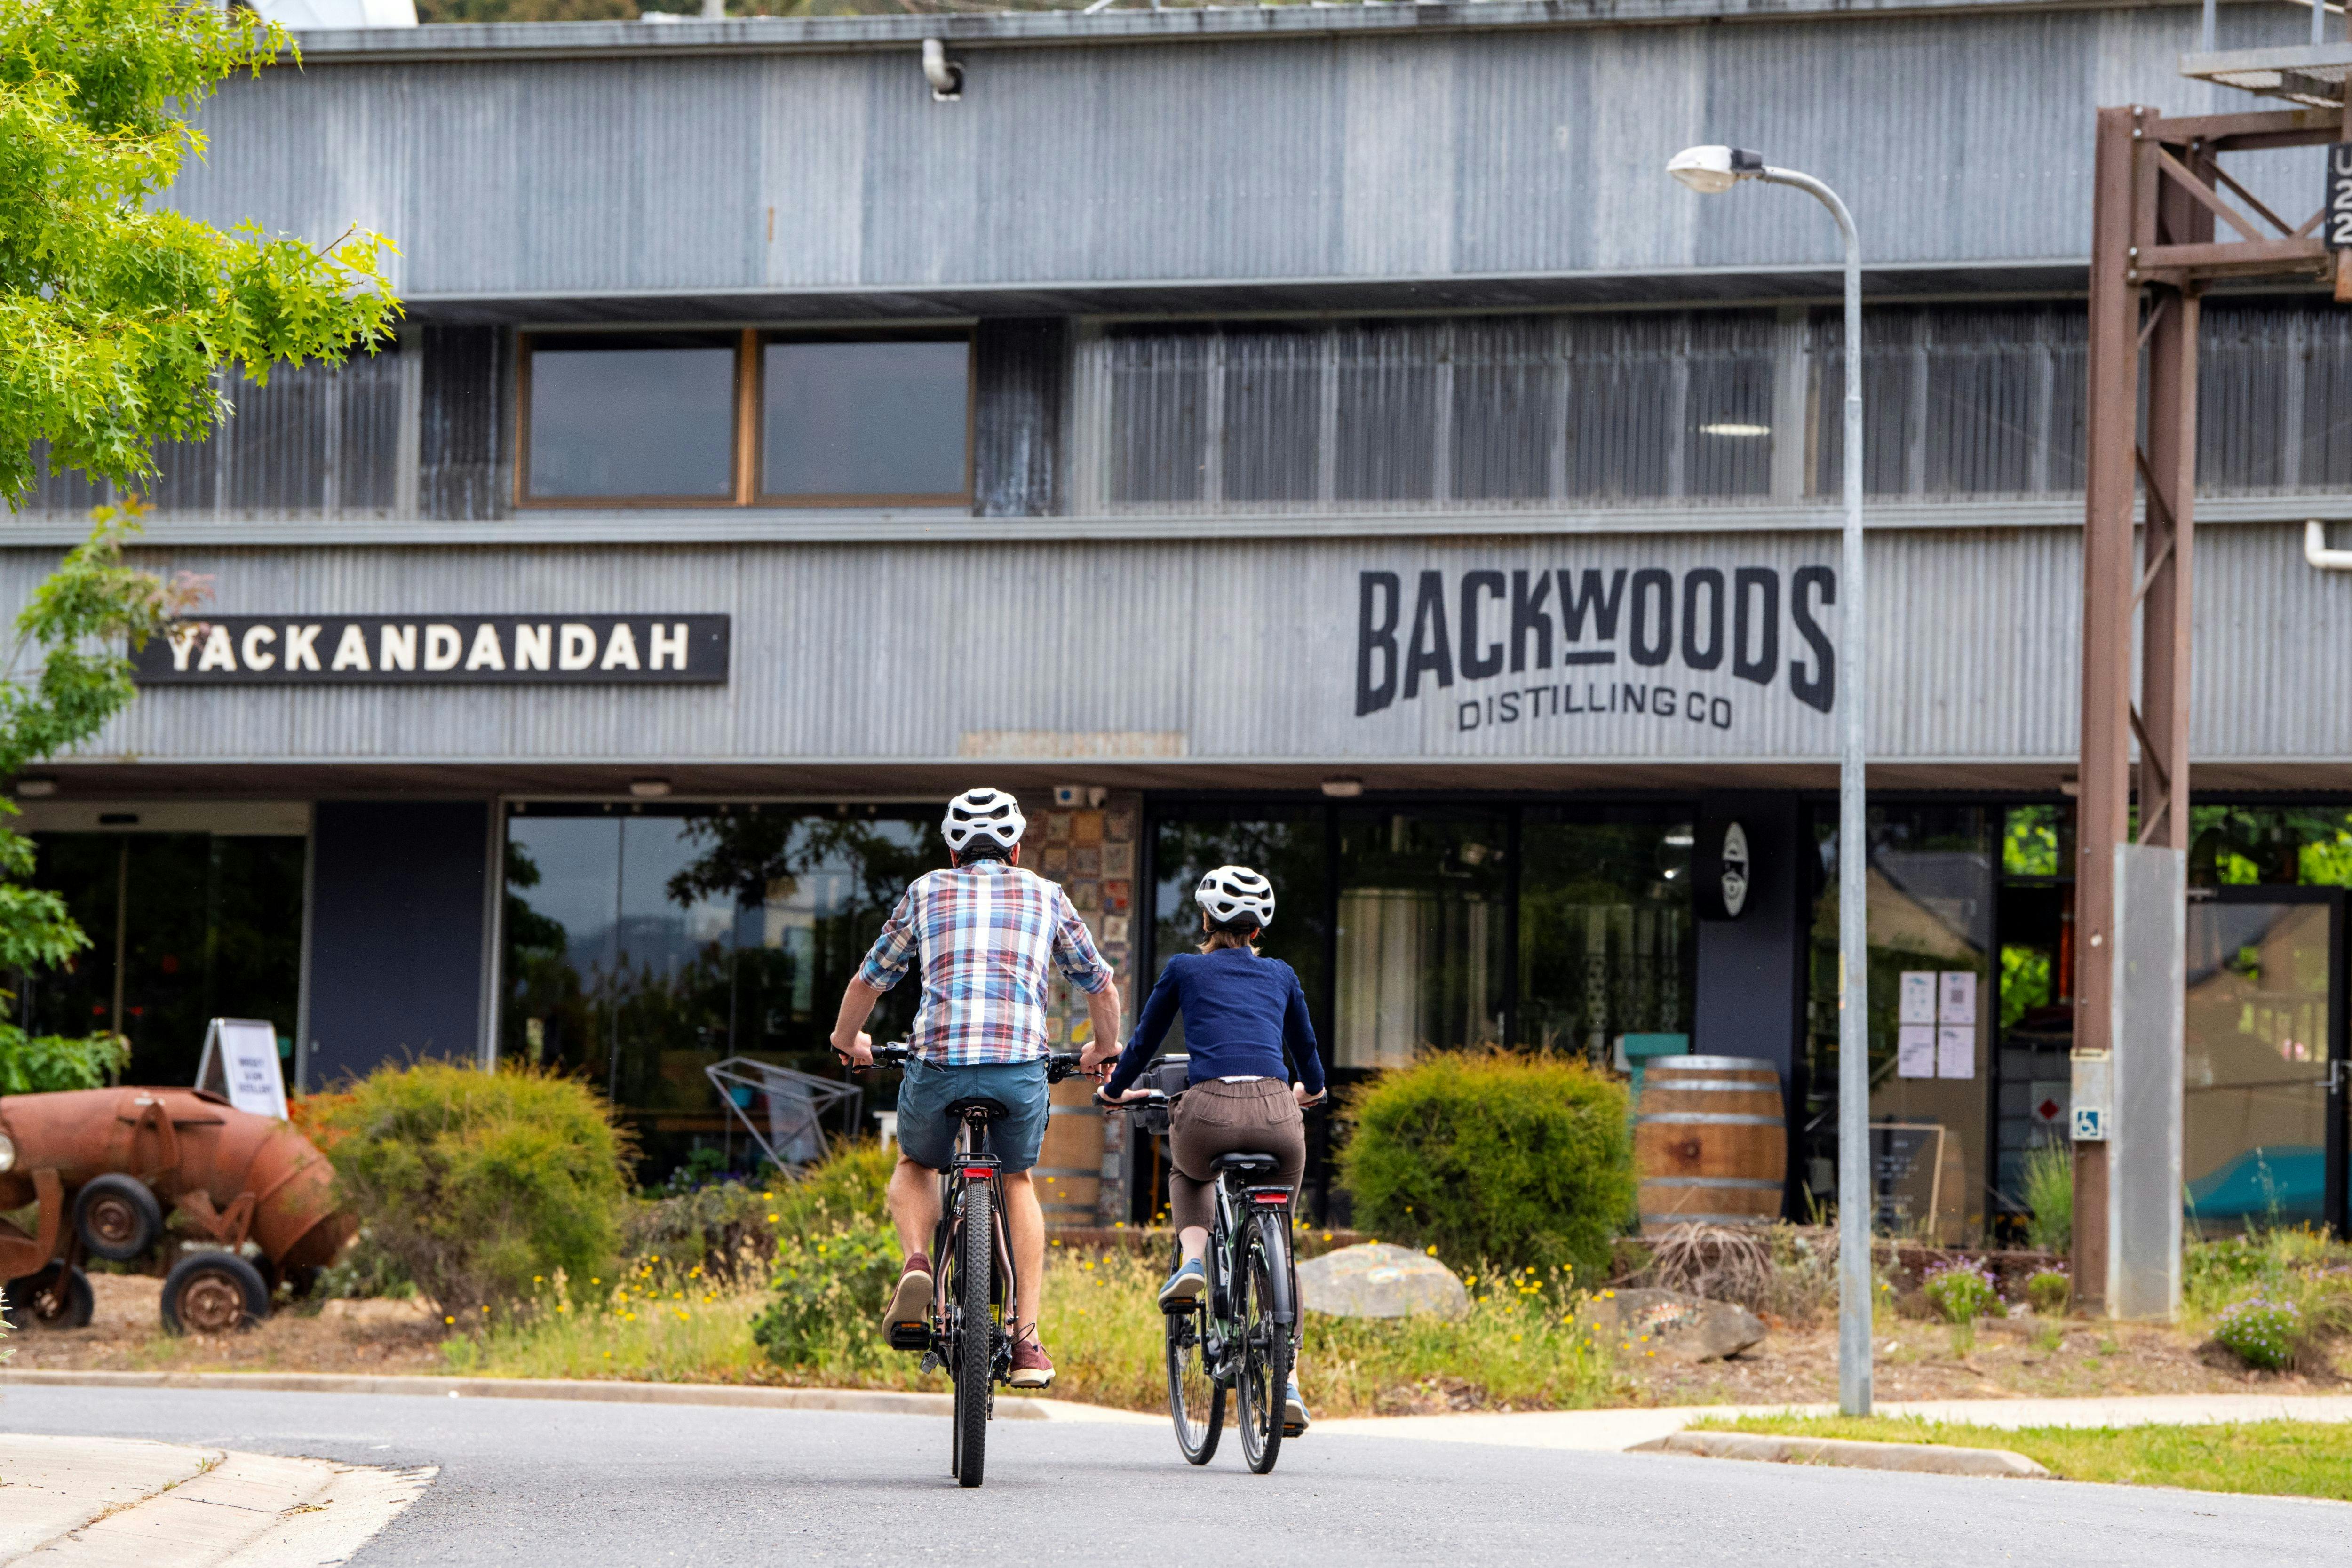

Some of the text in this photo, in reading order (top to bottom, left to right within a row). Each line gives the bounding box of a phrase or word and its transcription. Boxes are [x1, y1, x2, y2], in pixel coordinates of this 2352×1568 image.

[168, 623, 689, 672] YACKANDANDAH
[1355, 566, 1836, 716] BACKWOODS
[1459, 684, 1732, 732] DISTILLING CO
